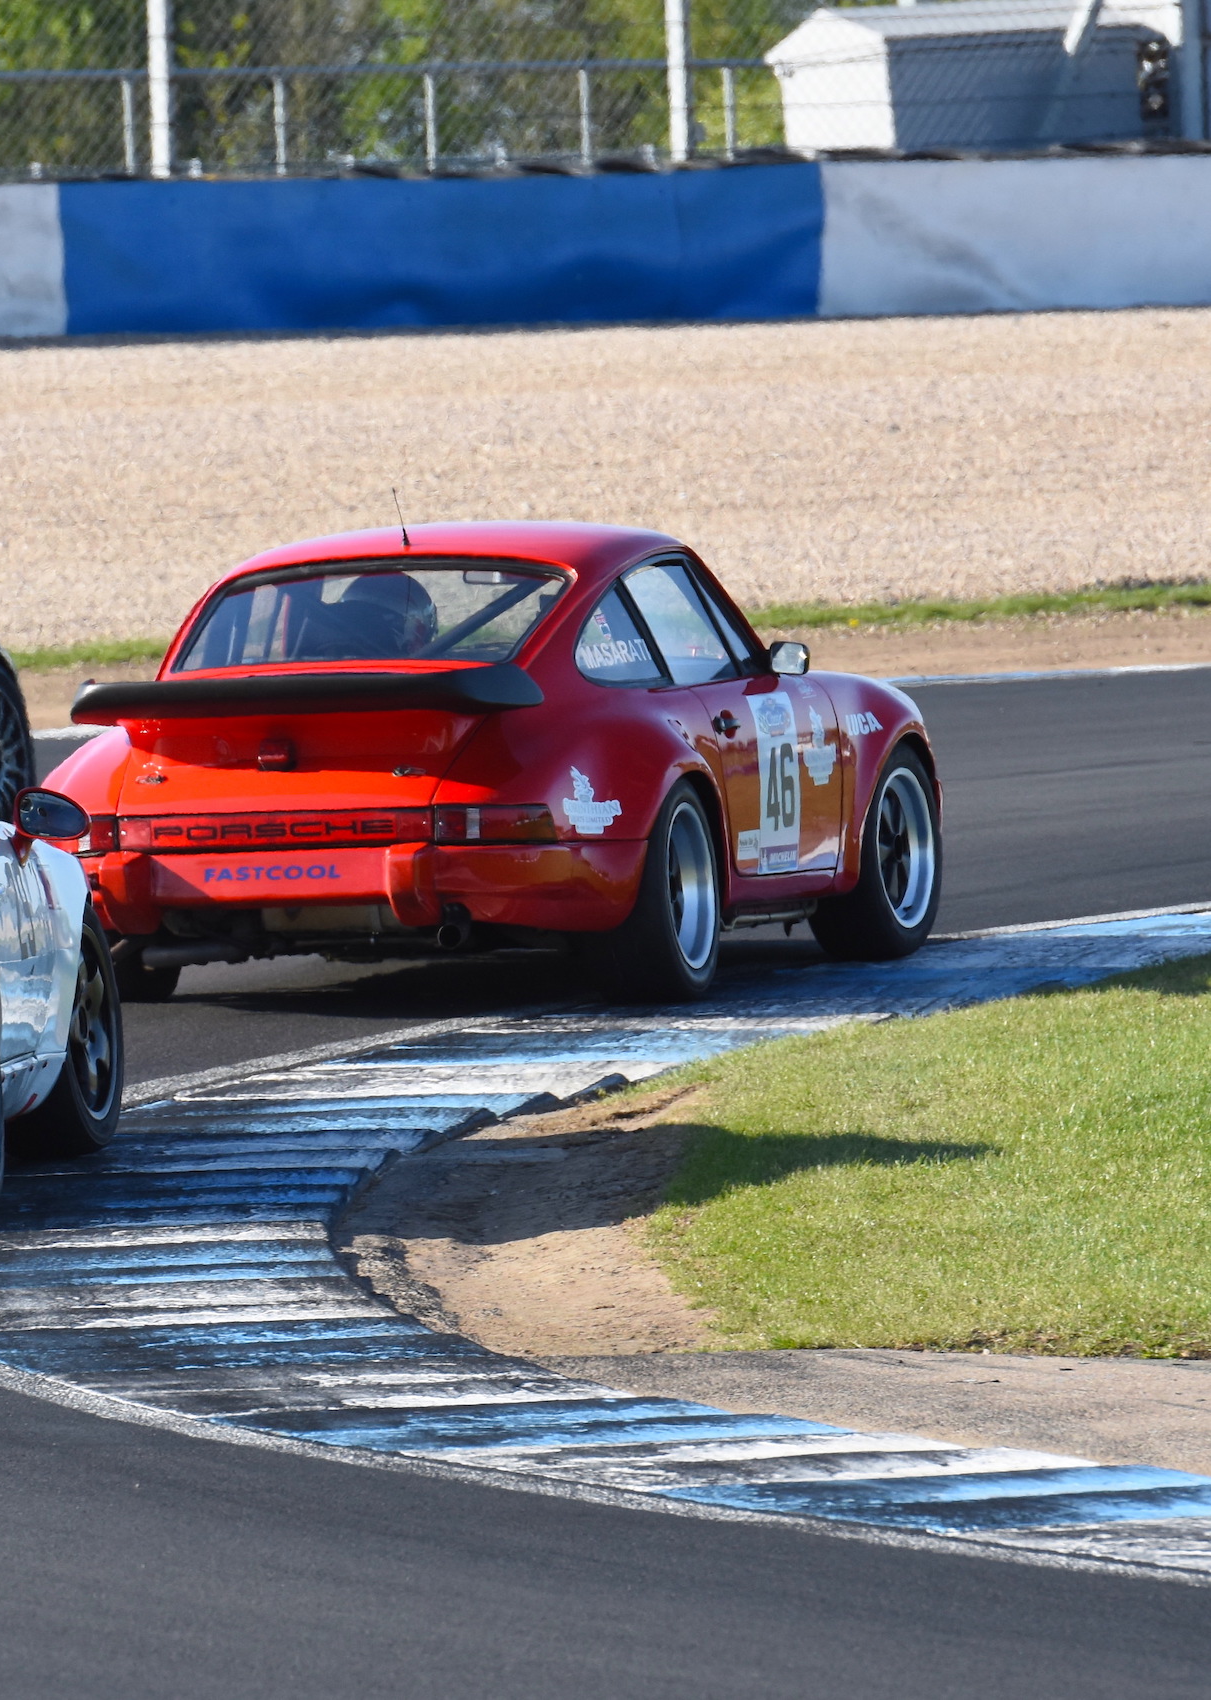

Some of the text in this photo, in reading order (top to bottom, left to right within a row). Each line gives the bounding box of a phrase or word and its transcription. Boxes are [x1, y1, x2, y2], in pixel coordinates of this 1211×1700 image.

[578, 638, 652, 669] MASARATI
[845, 711, 884, 736] LUCA
[767, 743, 796, 832] 46
[153, 819, 393, 841] PORSCHE
[204, 865, 341, 883] FASTCOOL
